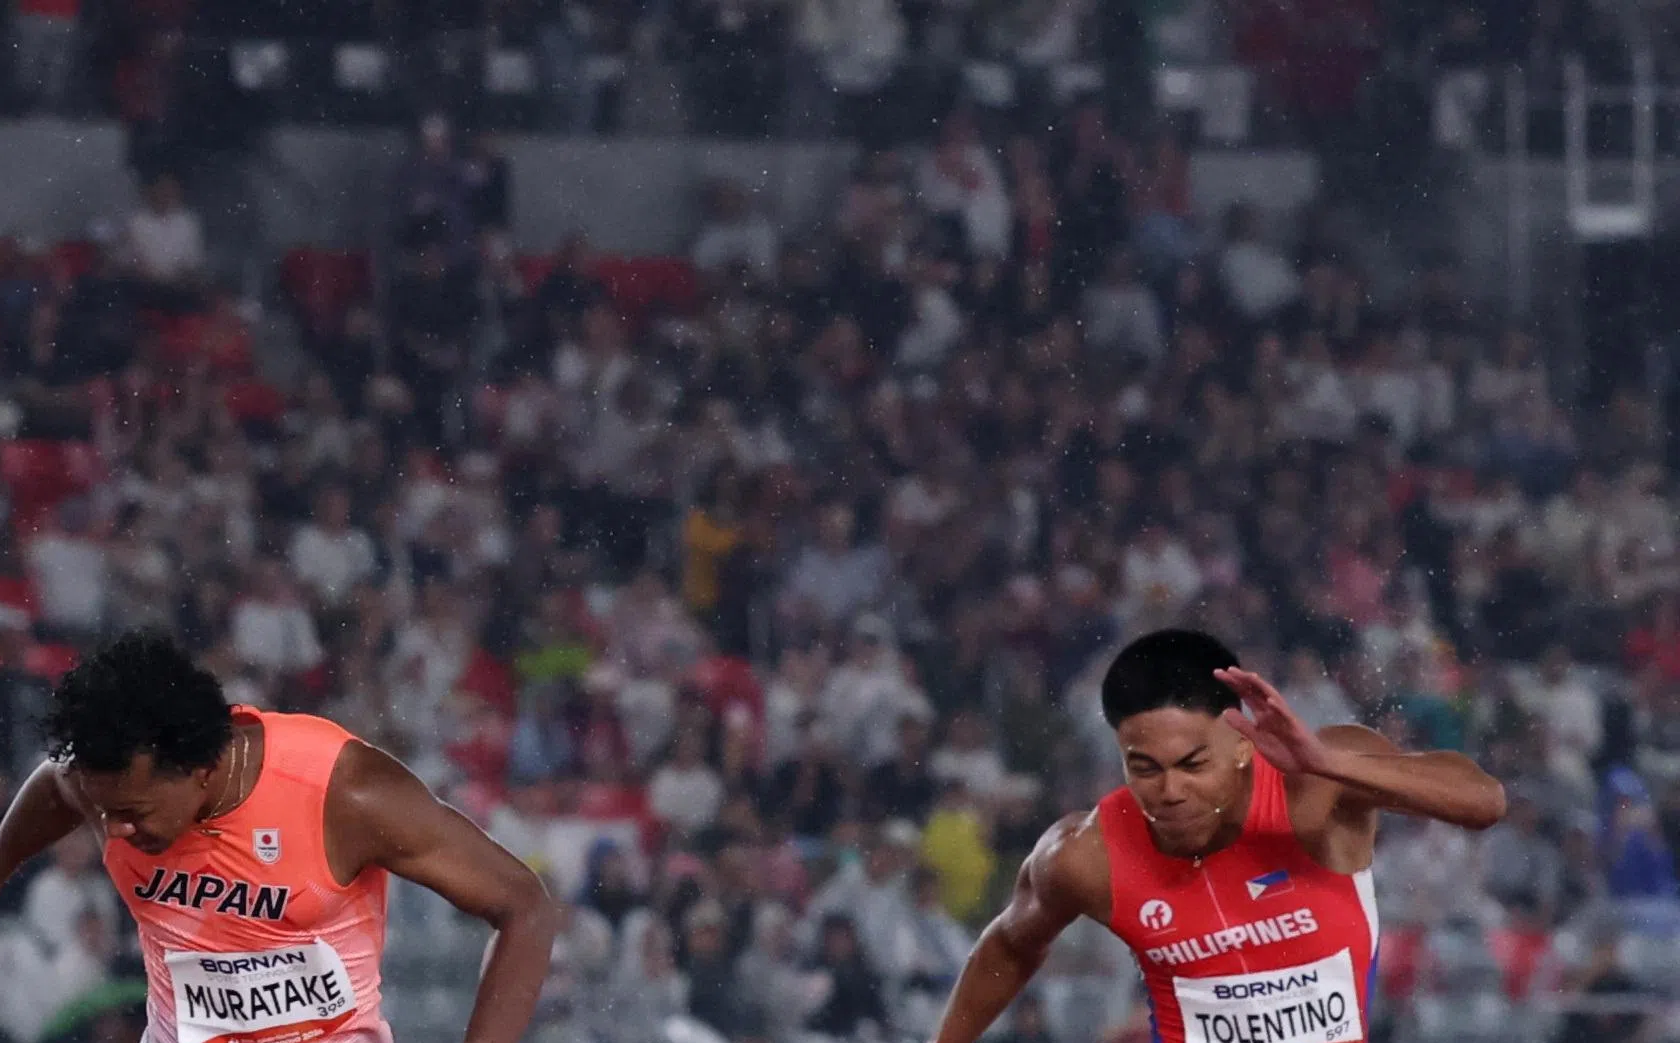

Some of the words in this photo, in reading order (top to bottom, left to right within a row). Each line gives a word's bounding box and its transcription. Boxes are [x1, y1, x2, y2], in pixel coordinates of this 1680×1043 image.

[134, 868, 289, 920] JAPAN
[1146, 908, 1319, 966] PHILIPPINES
[200, 951, 306, 975] BORNAN
[184, 970, 341, 1020] MURATAKE
[1213, 970, 1318, 999] BORNAN
[317, 997, 345, 1016] 398
